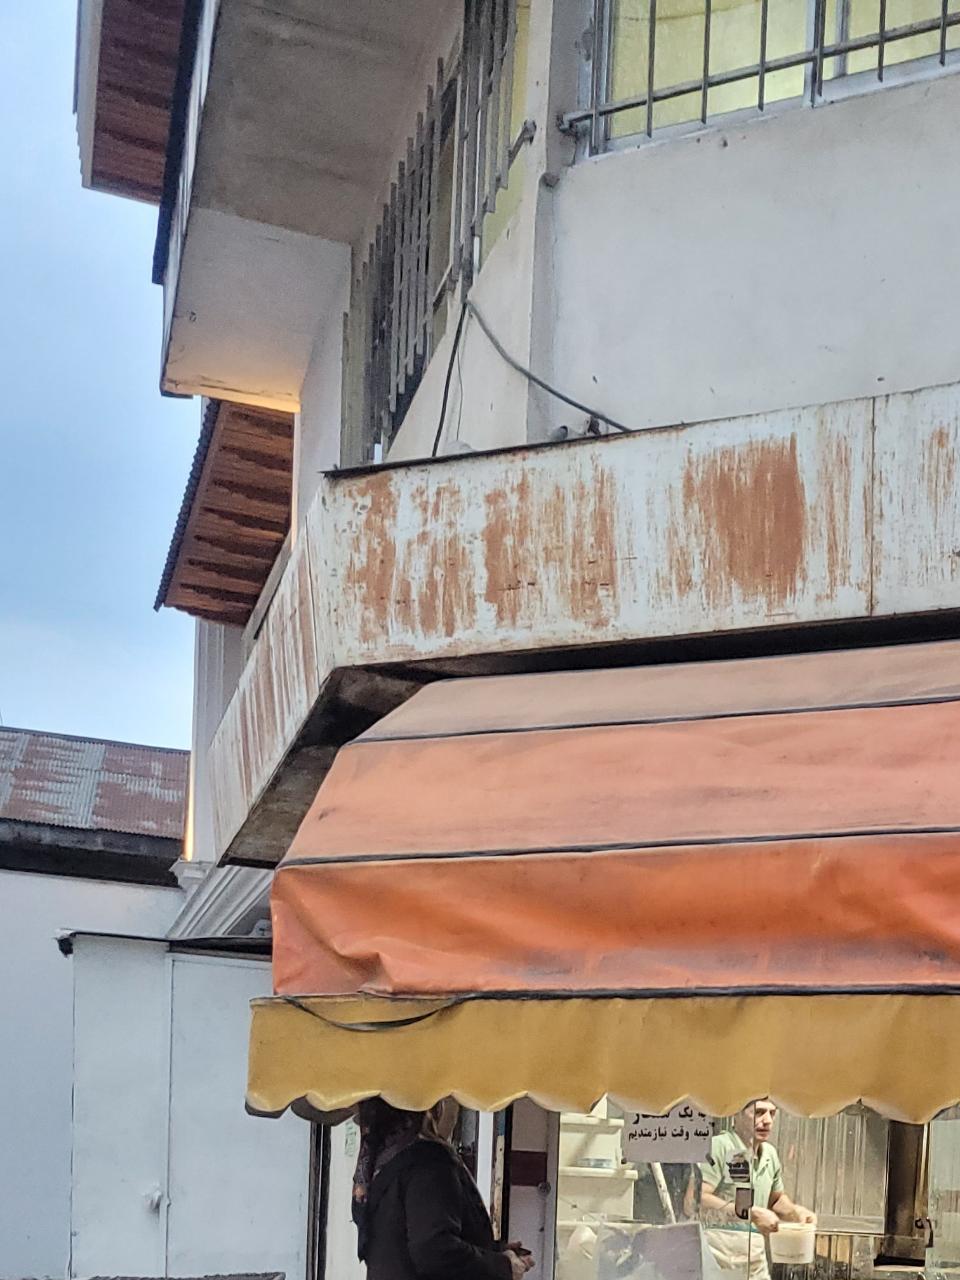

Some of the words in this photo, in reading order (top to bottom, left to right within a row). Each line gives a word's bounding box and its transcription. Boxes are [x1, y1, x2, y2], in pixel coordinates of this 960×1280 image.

[678, 1106, 693, 1121] یک
[628, 1126, 667, 1142] نیازمندیم
[671, 1125, 690, 1141] وقت
[693, 1126, 710, 1140] نیمه
